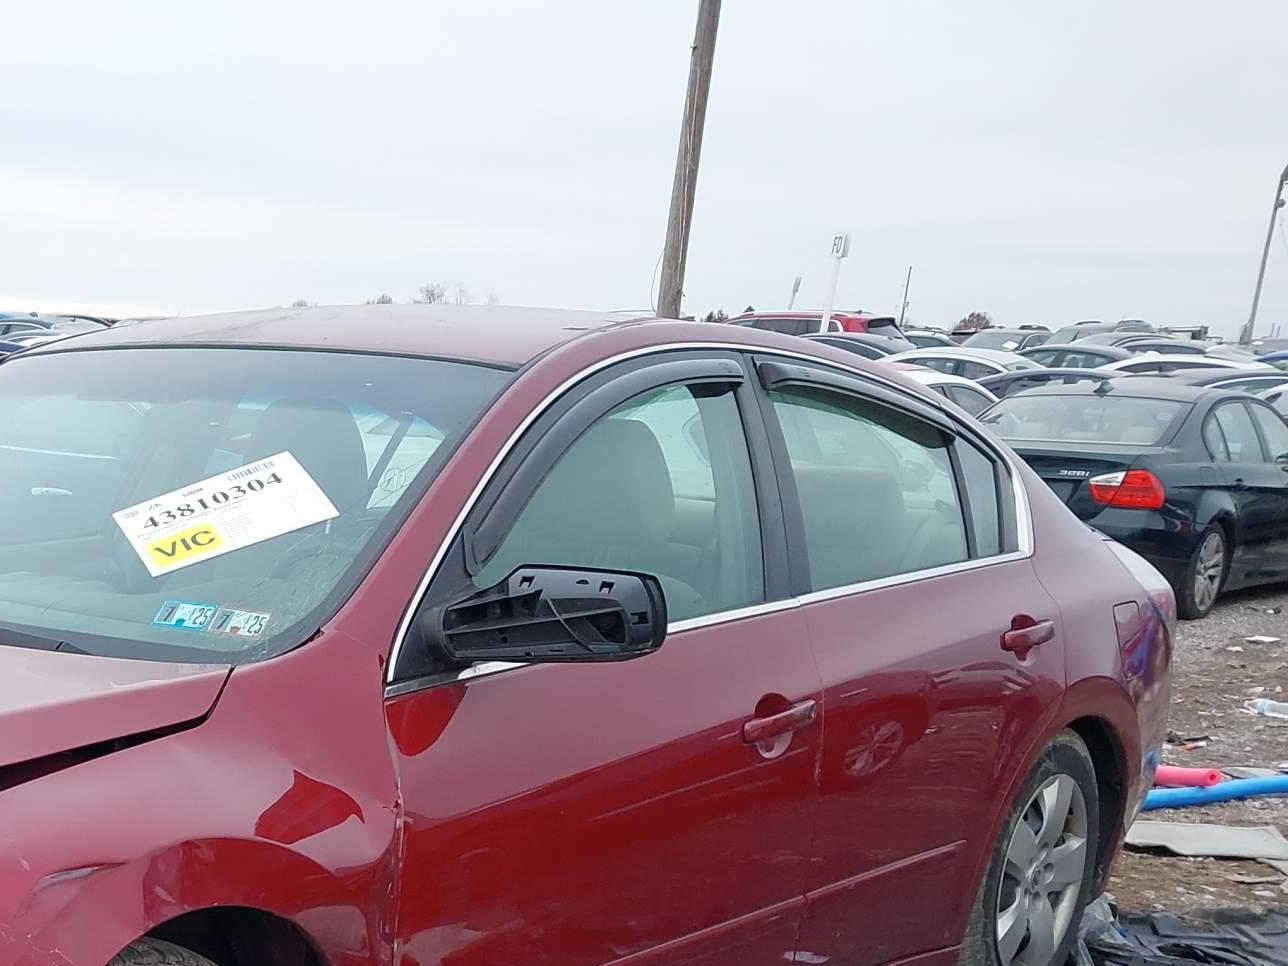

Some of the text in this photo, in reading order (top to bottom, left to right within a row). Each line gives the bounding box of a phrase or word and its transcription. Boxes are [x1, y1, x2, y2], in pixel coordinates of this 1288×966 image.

[143, 472, 284, 529] 43810304
[154, 530, 216, 558] VIC
[164, 606, 176, 622] 7
[217, 613, 233, 630] 7
